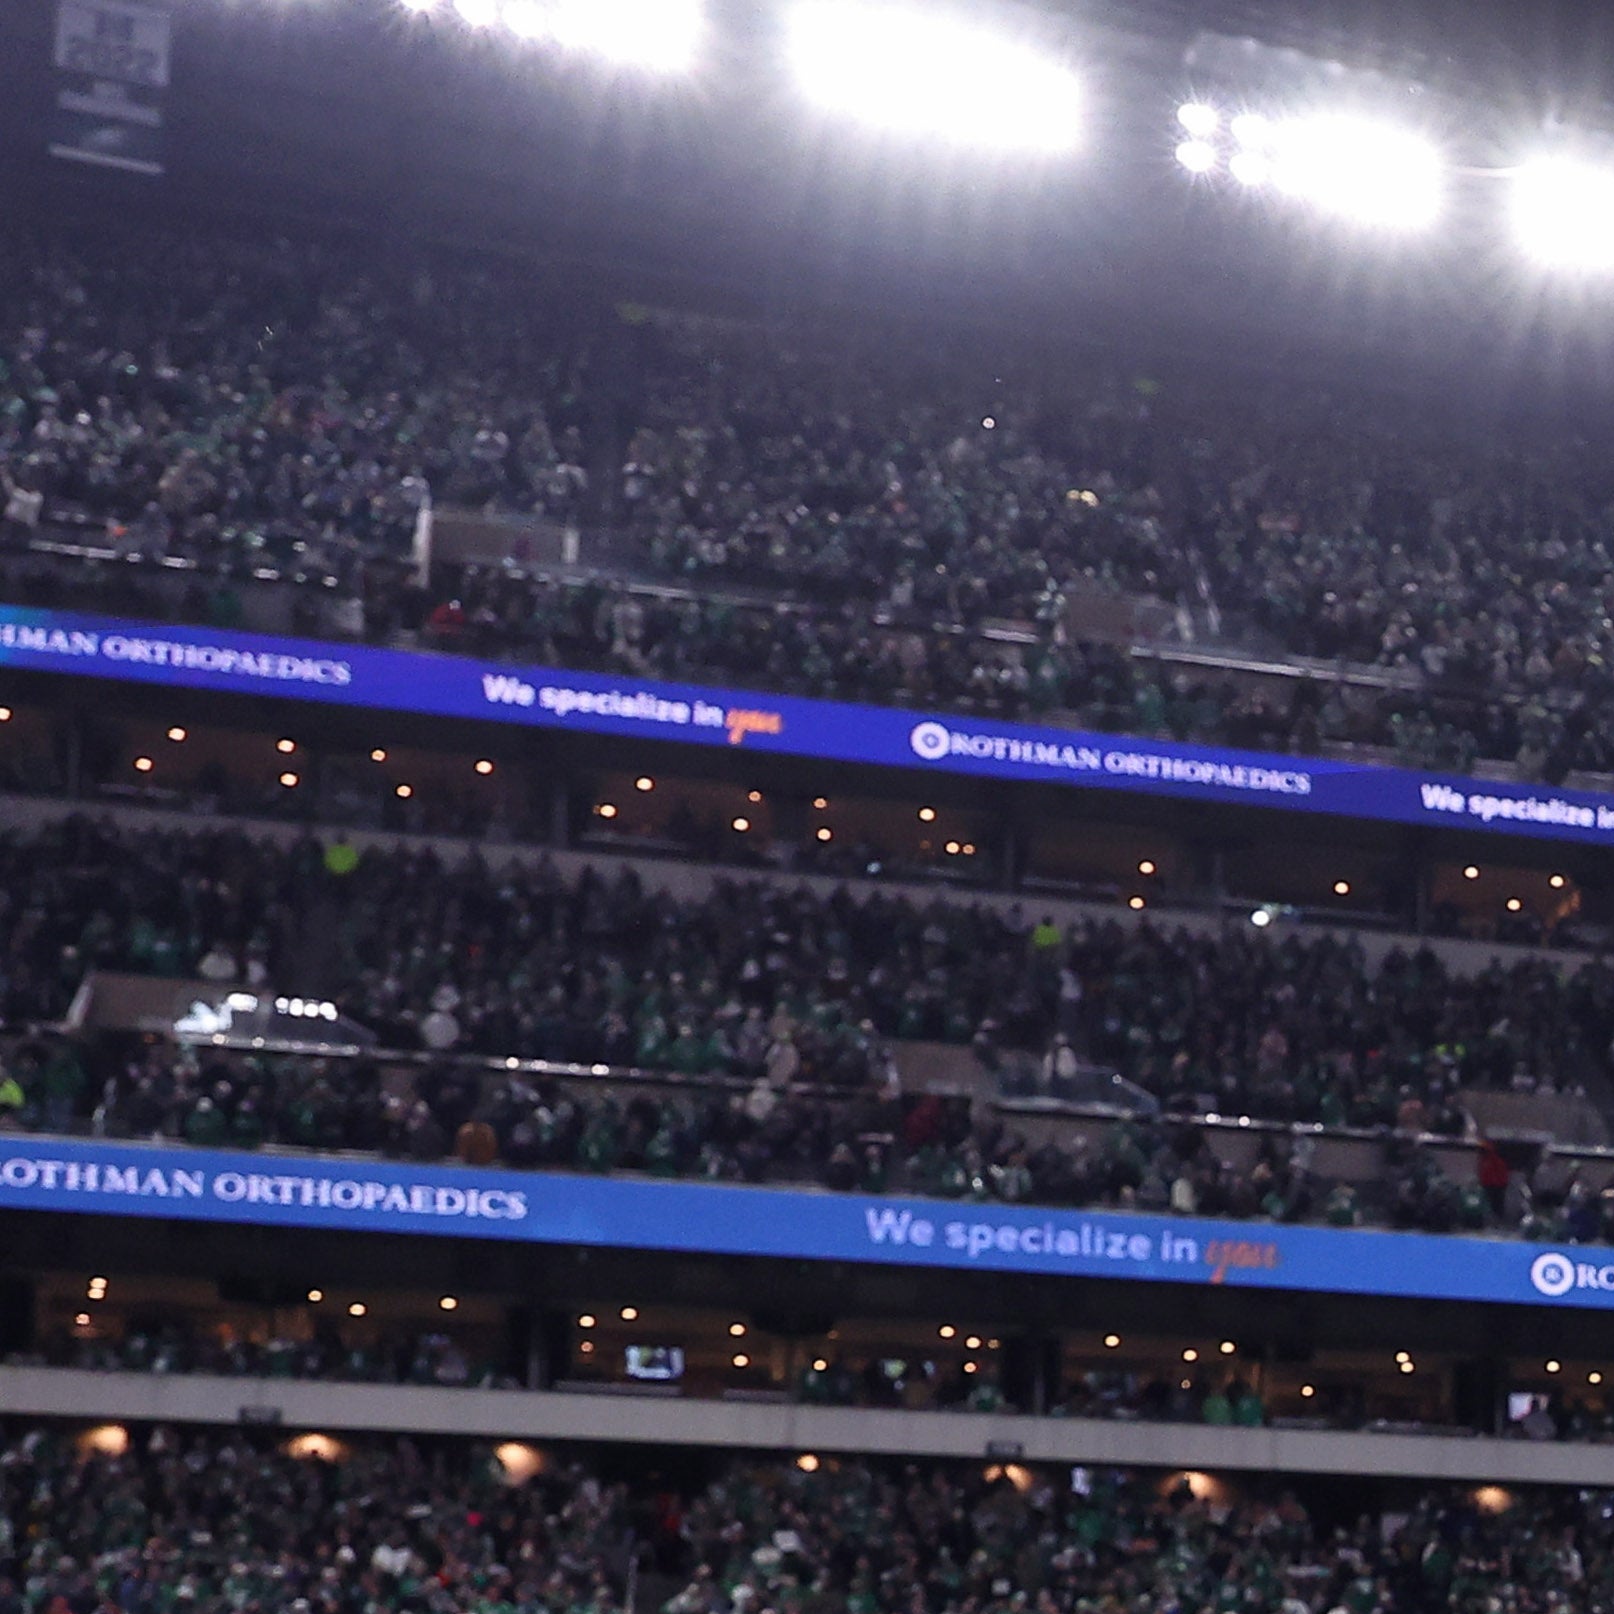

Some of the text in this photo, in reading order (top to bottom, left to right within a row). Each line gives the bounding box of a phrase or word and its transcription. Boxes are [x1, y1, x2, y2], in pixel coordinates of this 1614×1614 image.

[102, 635, 351, 686] ORTHOPAEDICS
[483, 674, 535, 707] We
[538, 686, 690, 724] specialize
[692, 699, 724, 728] in
[950, 732, 1312, 795] ROTHMAN ORTHOPAEDICS
[1420, 783, 1465, 813] We
[1468, 794, 1595, 827] specialize
[0, 1157, 528, 1220] OTHMAN ORTHOPAEDICS
[865, 1207, 934, 1246] We
[945, 1221, 1153, 1261] specialize
[1160, 1229, 1198, 1263] in
